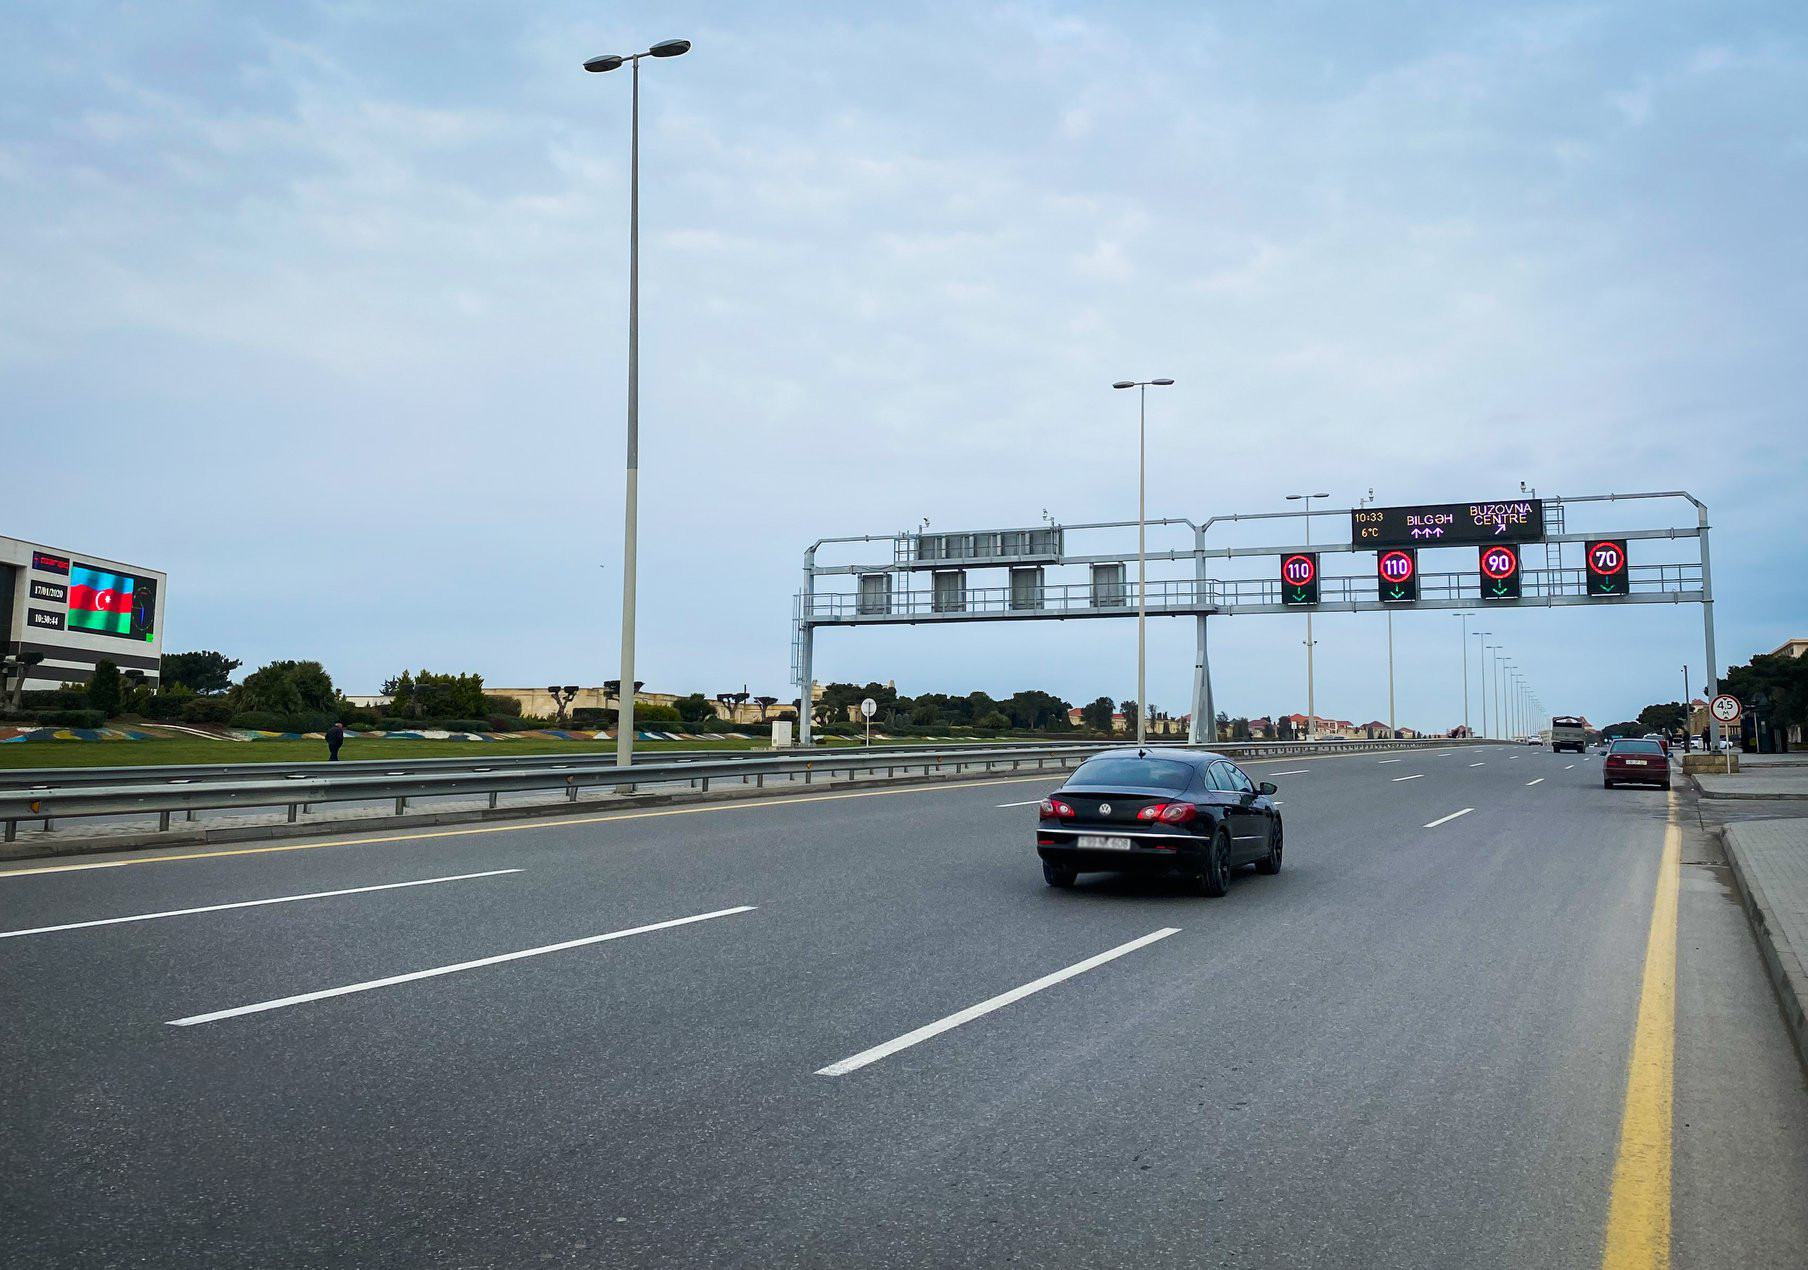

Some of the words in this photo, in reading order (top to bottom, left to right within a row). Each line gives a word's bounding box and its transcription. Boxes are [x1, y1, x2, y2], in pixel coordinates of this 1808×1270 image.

[1470, 503, 1532, 516] BUZOVNA
[1355, 512, 1383, 523] 10:33
[1407, 514, 1453, 526] BILGƏH
[1474, 514, 1527, 525] CENTRE
[1361, 527, 1379, 538] 6°C
[1488, 555, 1509, 571] 90
[1596, 551, 1617, 567] 70
[1288, 563, 1309, 579] 110
[1385, 559, 1408, 575] 110
[34, 586, 63, 598] 17/01/2020
[35, 614, 58, 625] 10:30:44
[1717, 701, 1733, 710] 4,5
